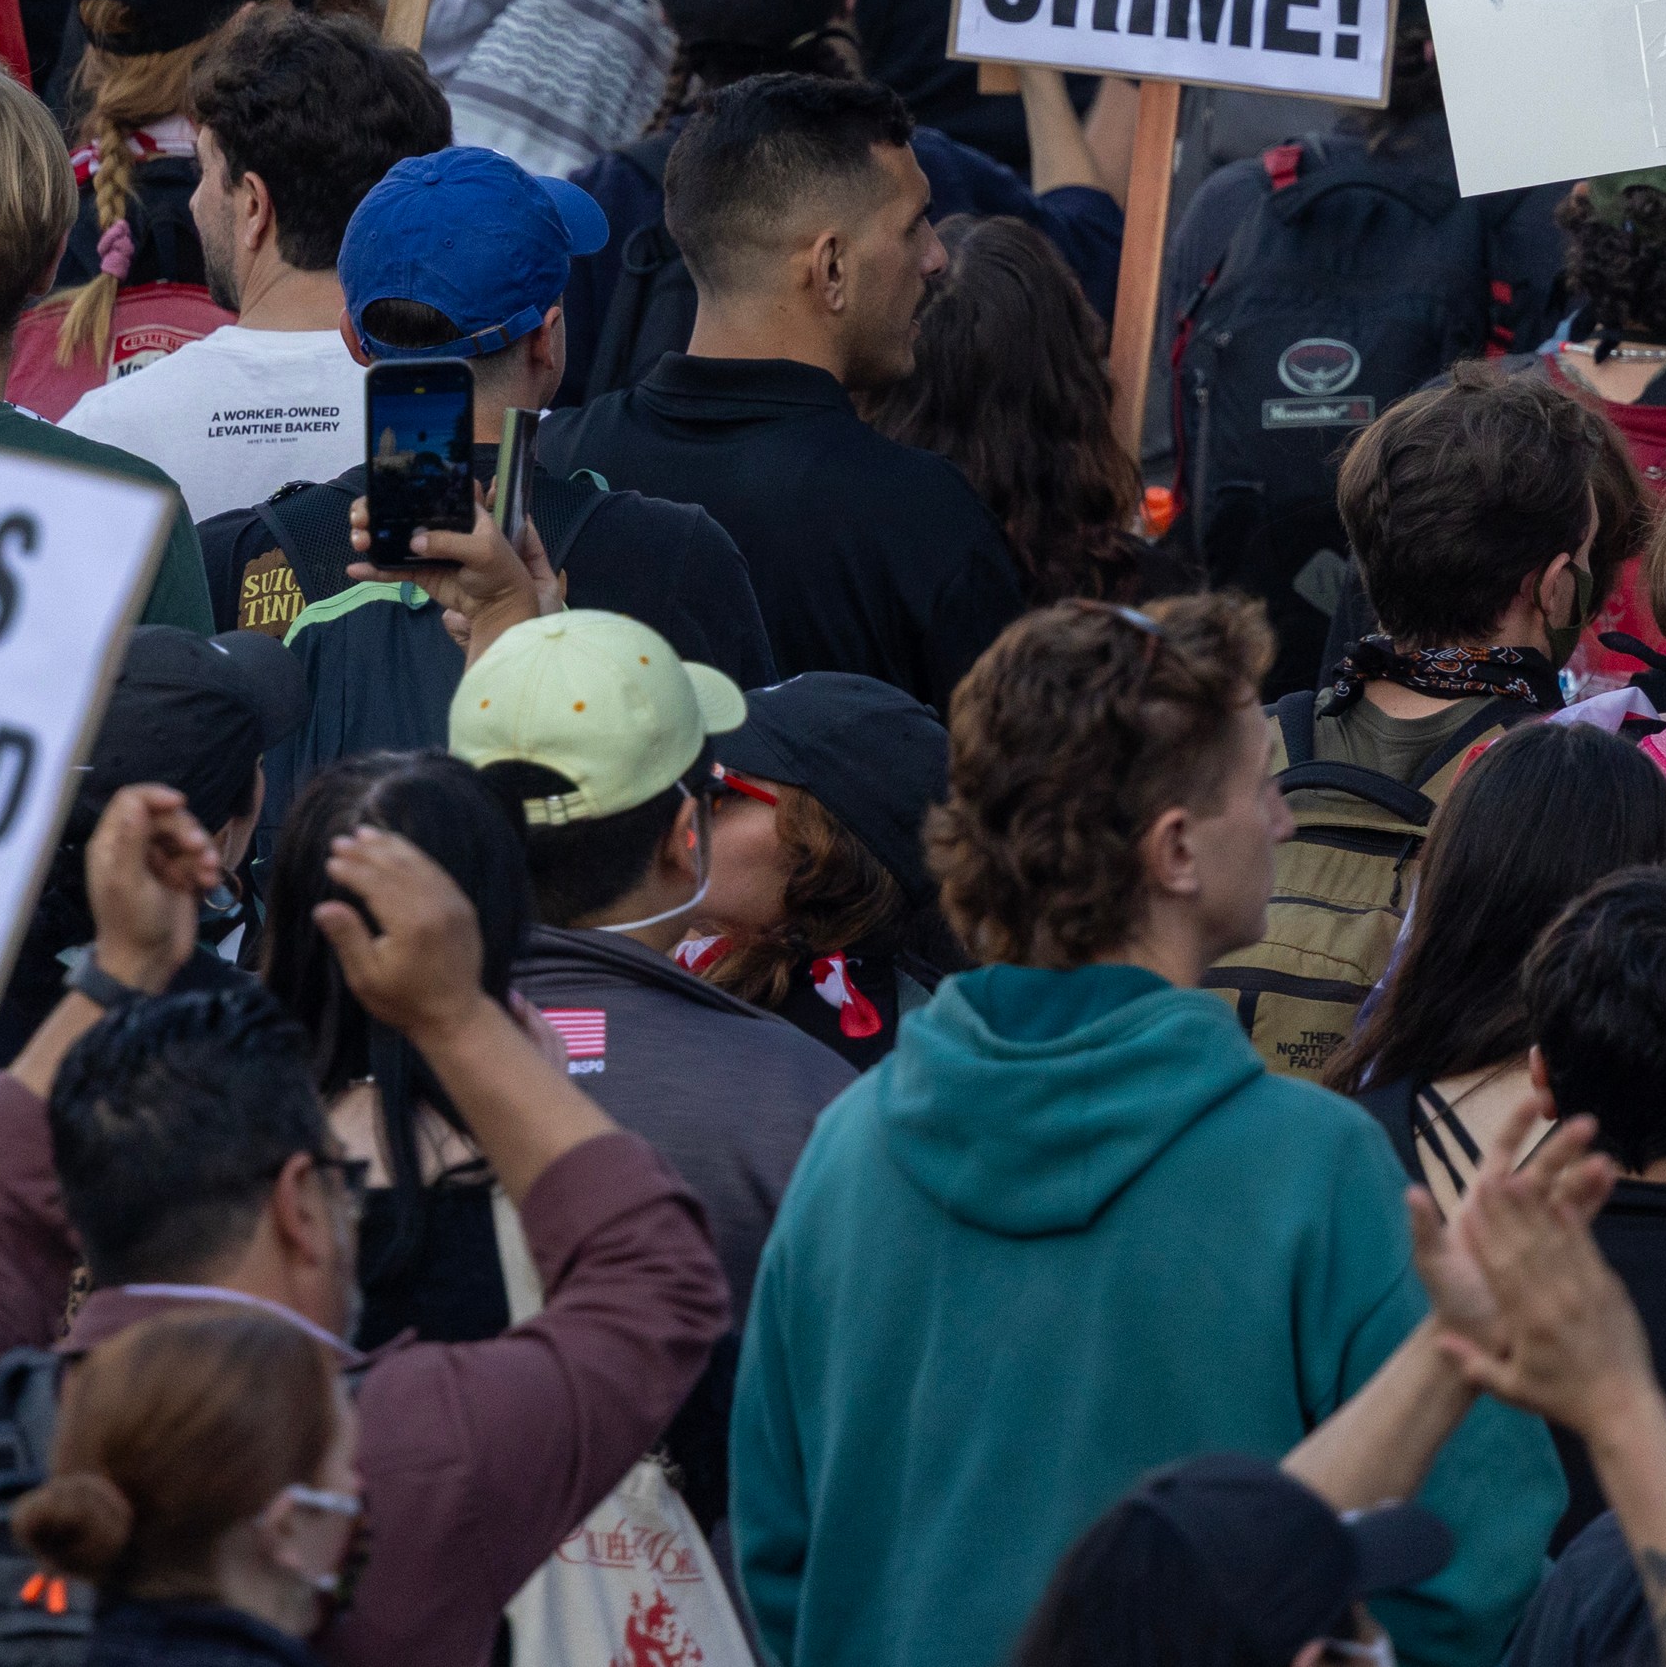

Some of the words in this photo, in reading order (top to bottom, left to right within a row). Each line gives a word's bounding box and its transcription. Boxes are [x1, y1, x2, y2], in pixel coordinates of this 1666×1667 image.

[212, 412, 221, 422] A
[224, 407, 340, 421] WORKER-OWNED
[208, 423, 282, 438] LEVANTINE
[285, 421, 341, 434] BAKERY
[243, 568, 300, 598] SUIC
[245, 593, 306, 627] TEND
[1300, 1032, 1330, 1044] THE
